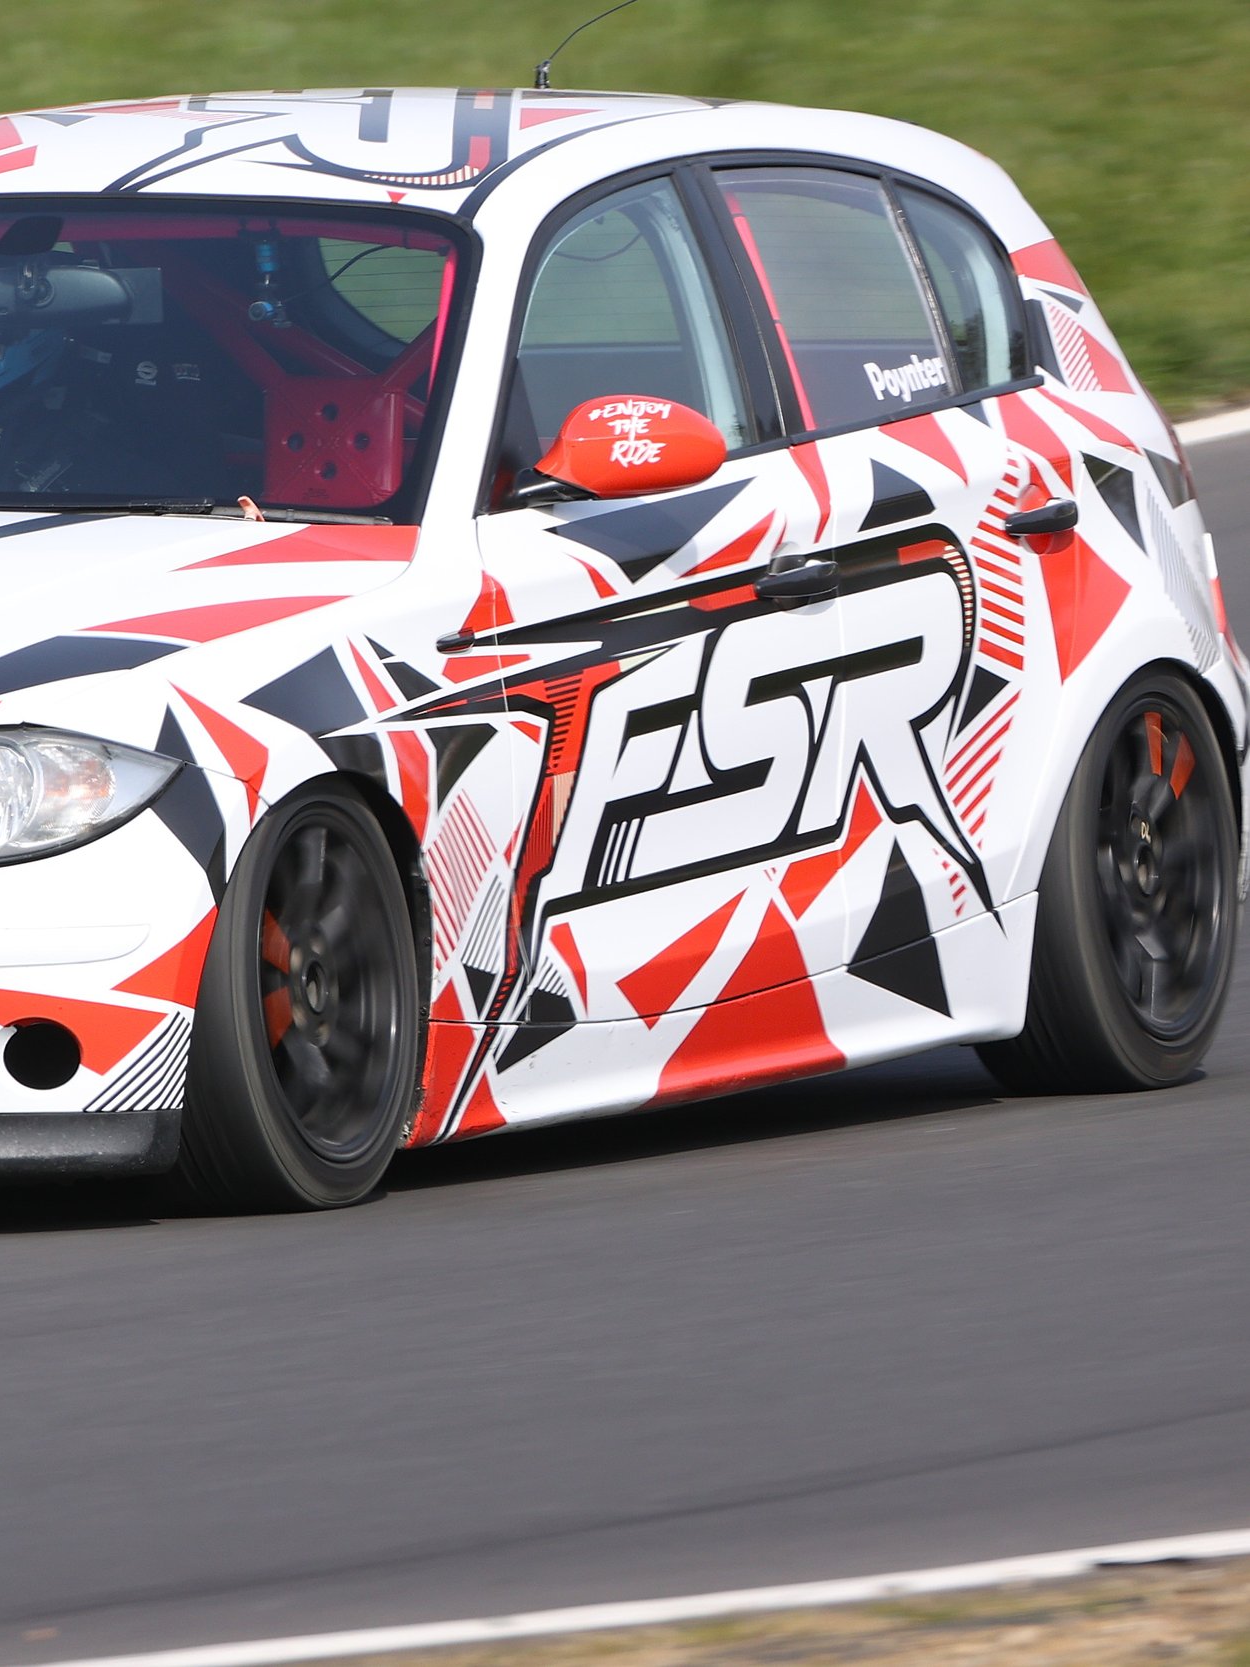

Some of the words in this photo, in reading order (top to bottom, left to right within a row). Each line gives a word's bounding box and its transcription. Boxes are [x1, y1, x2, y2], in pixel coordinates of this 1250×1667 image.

[863, 354, 946, 402] Poynter
[607, 417, 652, 438] THE
[609, 440, 667, 468] RIDE
